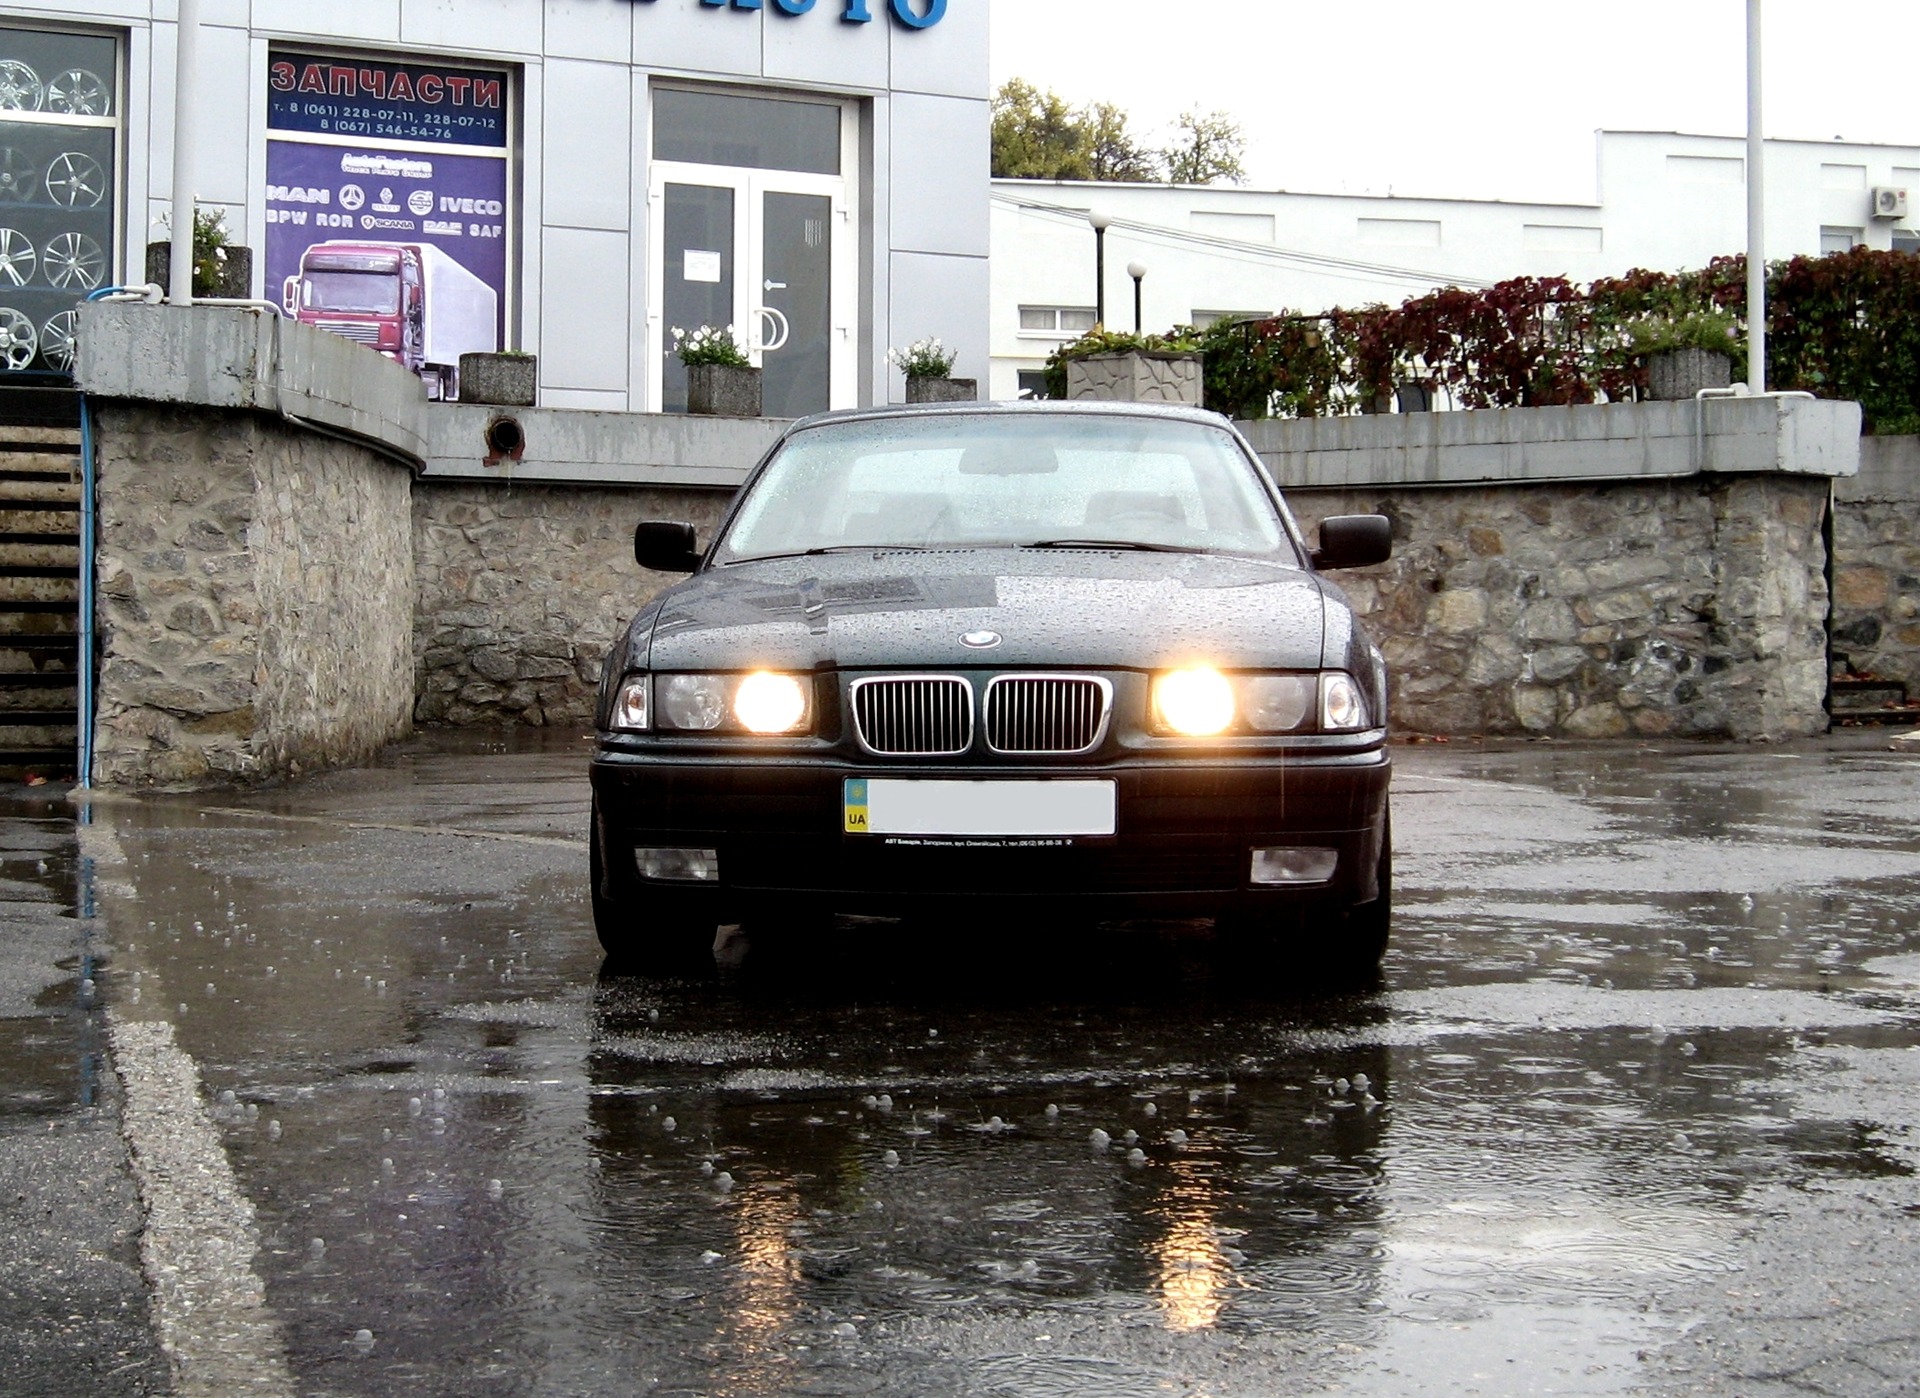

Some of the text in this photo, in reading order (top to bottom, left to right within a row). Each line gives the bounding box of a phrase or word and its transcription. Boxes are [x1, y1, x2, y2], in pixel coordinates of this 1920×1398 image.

[271, 61, 500, 109] ЗАПЧАСТИ
[290, 102, 299, 113] 8
[304, 103, 338, 118] (061)
[343, 107, 418, 124] 228-07-11,
[424, 113, 496, 129] 228-07-12
[320, 119, 452, 139] 8 (067) 546-54-76
[266, 185, 330, 204] MAN
[440, 196, 502, 216] IVECO
[266, 209, 353, 228] BPW ROR
[375, 218, 415, 230] SCANIA
[469, 224, 502, 238] SAF
[849, 814, 866, 825] UA
